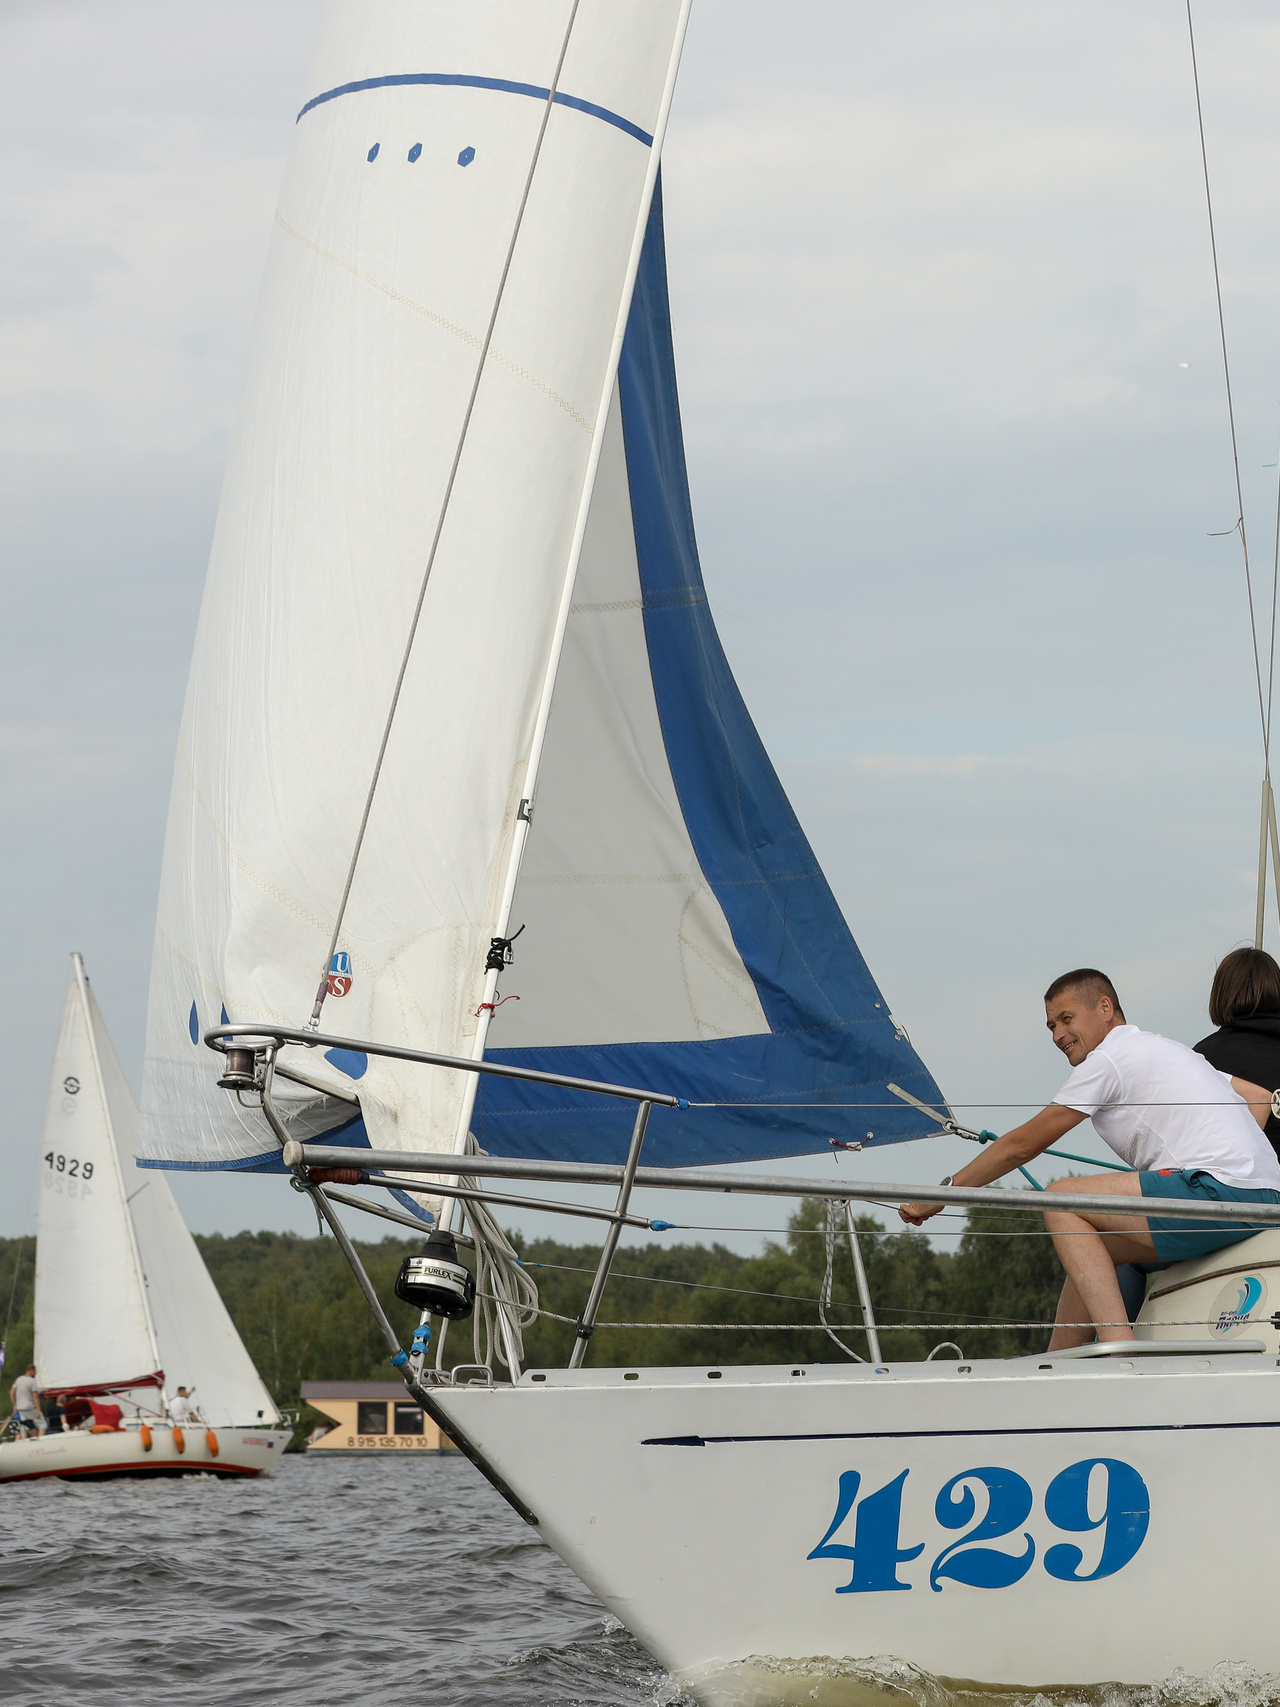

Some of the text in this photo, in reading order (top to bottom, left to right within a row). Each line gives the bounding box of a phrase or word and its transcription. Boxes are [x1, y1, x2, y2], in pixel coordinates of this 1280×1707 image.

[44, 1151, 94, 1180] 4929
[424, 1267, 452, 1280] FURLEX
[347, 1436, 428, 1447] 8 915 135 70 10
[806, 1457, 1150, 1594] 429
